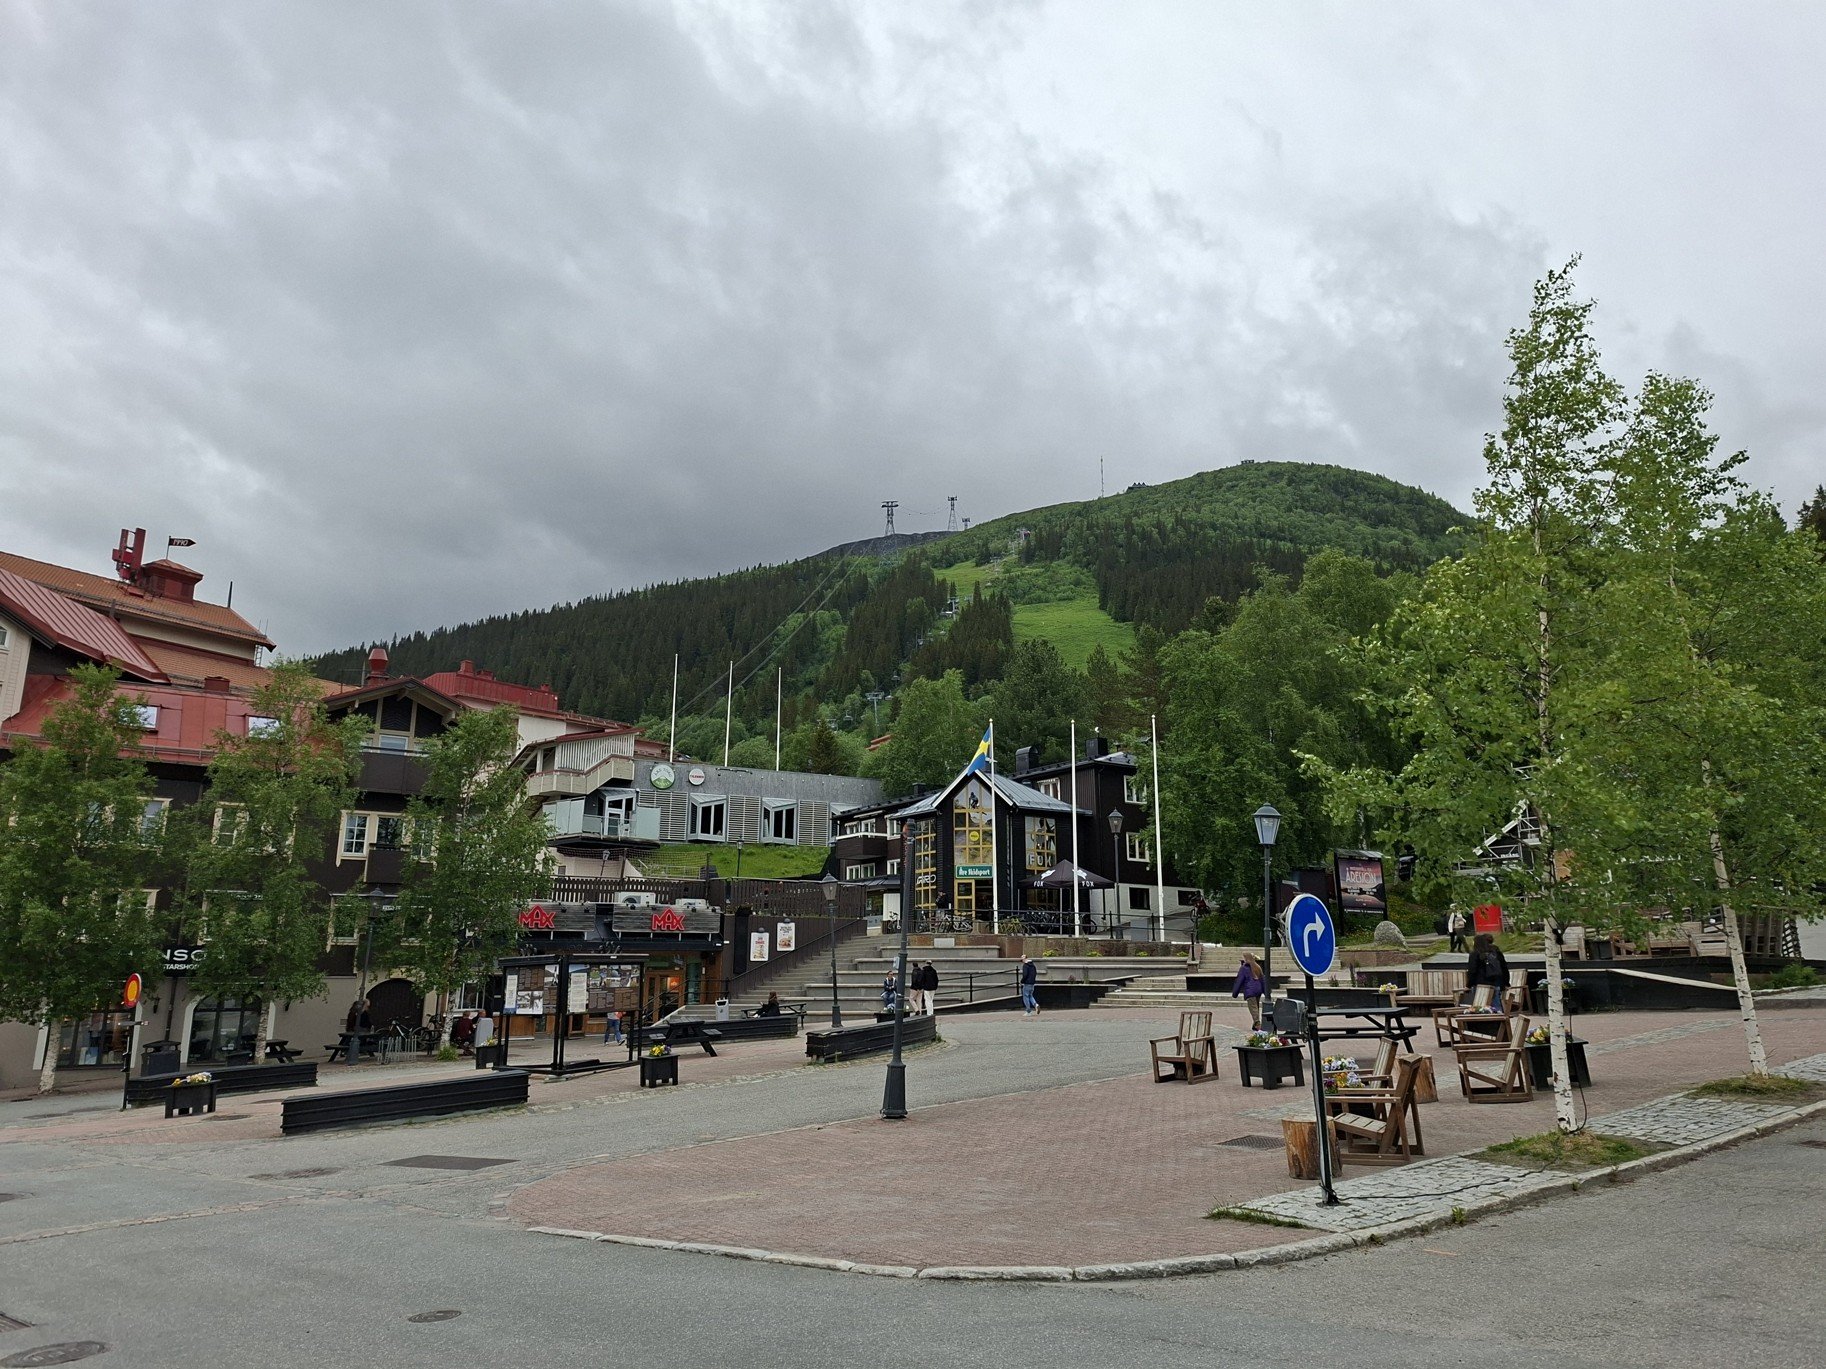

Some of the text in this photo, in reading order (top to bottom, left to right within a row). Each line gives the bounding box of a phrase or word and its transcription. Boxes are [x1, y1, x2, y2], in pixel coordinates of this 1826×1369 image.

[1029, 853, 1052, 867] FOX
[916, 874, 937, 885] GIRO
[519, 904, 557, 929] MAX
[652, 907, 686, 932] MAX
